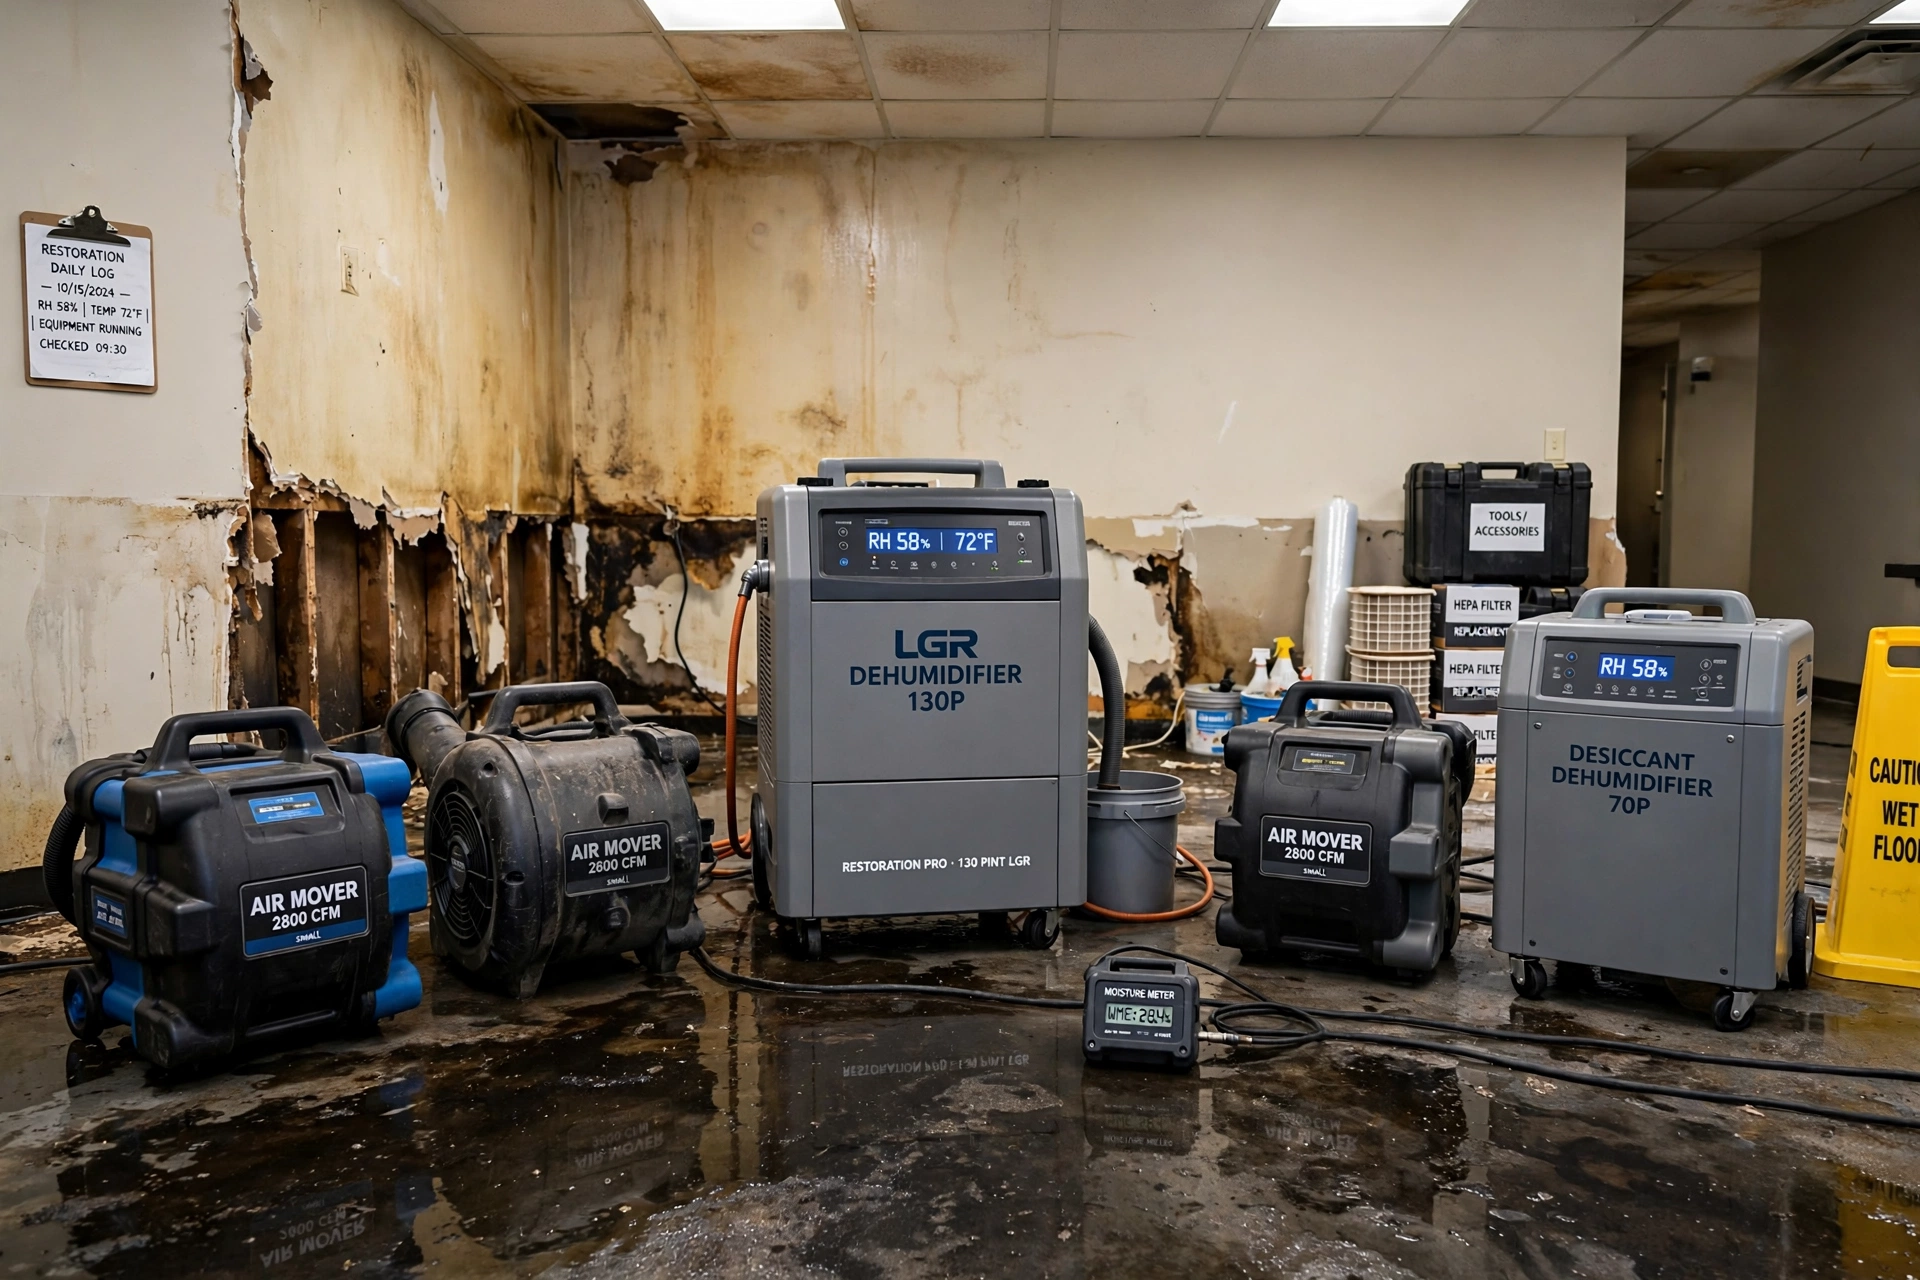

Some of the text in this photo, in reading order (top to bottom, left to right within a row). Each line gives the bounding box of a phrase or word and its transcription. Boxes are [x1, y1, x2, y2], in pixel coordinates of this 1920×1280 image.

[42, 244, 124, 263] RESTORATION
[51, 262, 114, 279] DAILY LOG
[57, 282, 114, 297] 10/15/2024
[38, 300, 52, 310] RH
[57, 302, 78, 312] 58%
[91, 305, 116, 316] TEMP
[40, 318, 142, 336] EQUIPMENT RUNNING
[40, 339, 127, 354] CHECKED 09:30
[1475, 526, 1539, 537] ACCESSORIES
[869, 532, 891, 549] RH
[897, 532, 930, 550] 58%
[1454, 600, 1478, 611] HEPA
[1481, 600, 1512, 611] FILTER
[895, 629, 978, 659] LGR
[850, 664, 1022, 685] DEHUMIDIFIER
[1450, 664, 1502, 674] HEPA FILTE
[1600, 657, 1668, 678] RH 58%
[908, 691, 965, 711] 130P
[1474, 730, 1496, 740] FILTE
[1570, 744, 1695, 771] DESICCANT
[1552, 766, 1713, 798] DEHUMIDIFIER
[1609, 795, 1650, 814] 70P
[1882, 800, 1919, 827] WET
[571, 834, 662, 861] AIR MOVER
[1268, 827, 1363, 851] AIR MOVER
[1284, 847, 1344, 864] 2800 CFM
[1874, 834, 1920, 863] FLOO
[622, 855, 646, 869] CFM
[842, 856, 1031, 872] RESTORATION PRO 130 PINT LGR
[250, 880, 358, 917] AIR MOVER
[272, 905, 341, 931] 2800 CFM
[1105, 987, 1174, 999] MOISTURE METER
